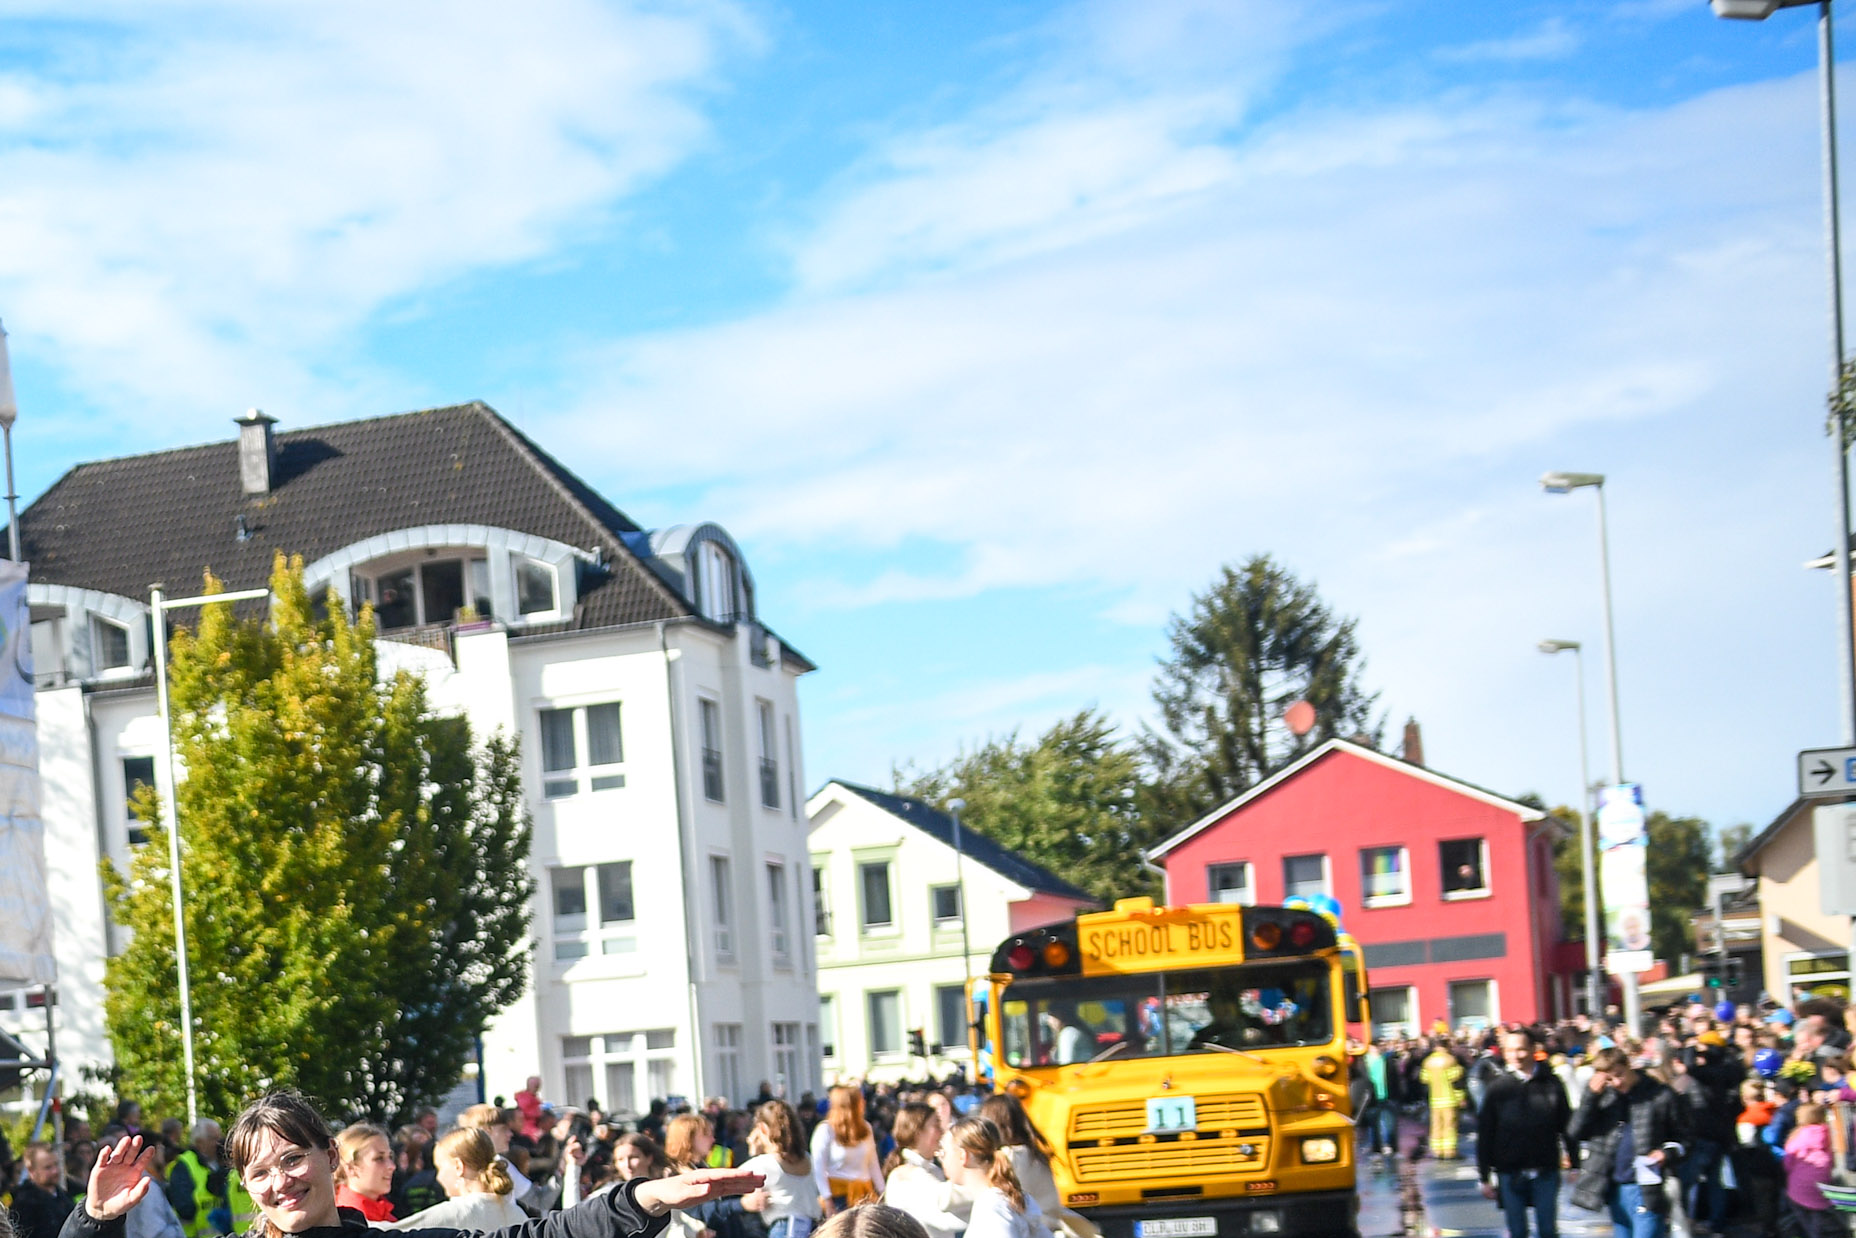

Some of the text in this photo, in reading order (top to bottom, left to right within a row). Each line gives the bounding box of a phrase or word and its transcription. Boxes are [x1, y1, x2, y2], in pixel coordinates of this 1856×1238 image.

[1089, 920, 1233, 961] SCHOOL BUS
[1155, 1105, 1190, 1127] 11
